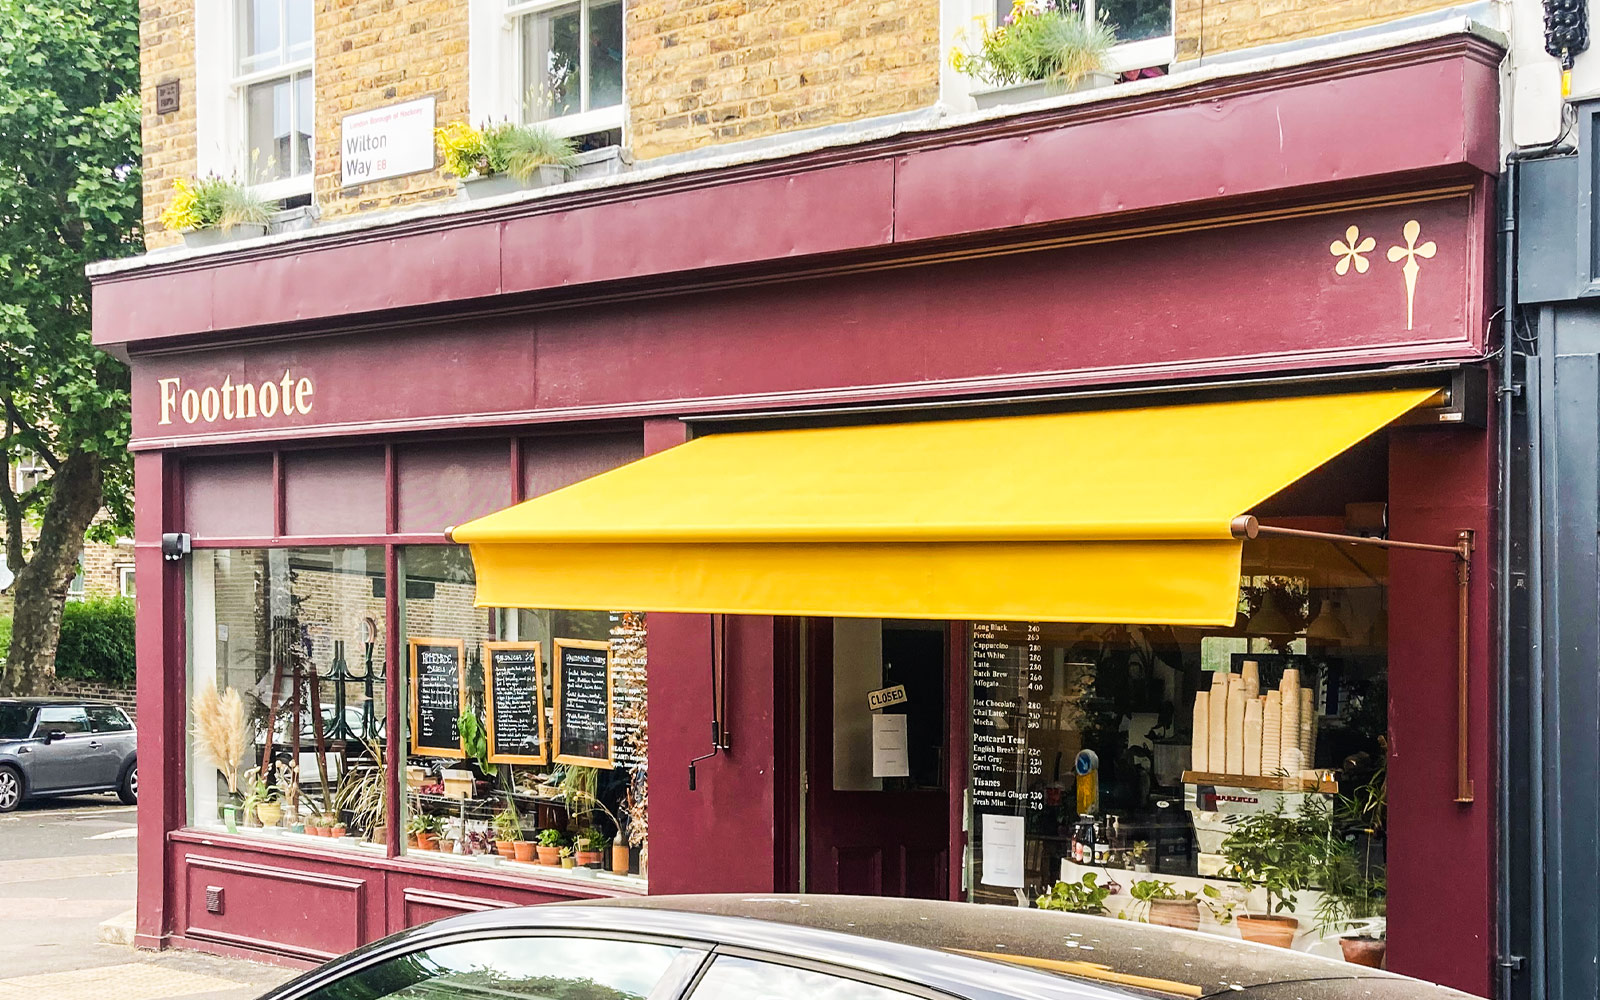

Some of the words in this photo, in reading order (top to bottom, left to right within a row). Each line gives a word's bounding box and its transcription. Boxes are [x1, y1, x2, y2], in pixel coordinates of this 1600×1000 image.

[346, 134, 387, 155] Wilton
[346, 158, 371, 177] Way
[377, 159, 387, 171] E8
[158, 368, 313, 425] Footnote
[973, 623, 989, 632] Long
[990, 624, 1008, 632] Black
[973, 641, 1009, 650] Cappuccino
[973, 651, 986, 659] Flat
[987, 651, 1005, 660] White
[973, 670, 990, 678] Batch
[993, 670, 1008, 678] Brew
[974, 679, 999, 688] Affogato
[871, 689, 904, 706] CLOSED
[985, 699, 1015, 709] Chocolate
[973, 718, 994, 726] Mocha
[973, 733, 1005, 743] Postcard
[1007, 735, 1025, 744] Teas
[973, 744, 995, 753] English
[973, 763, 990, 771] Green
[973, 778, 1000, 787] Tisanes
[973, 788, 994, 796] Lemon
[994, 789, 1006, 797] and
[1007, 790, 1029, 800] Ginger
[973, 797, 990, 806] Fresh
[990, 798, 1006, 807] Mint
